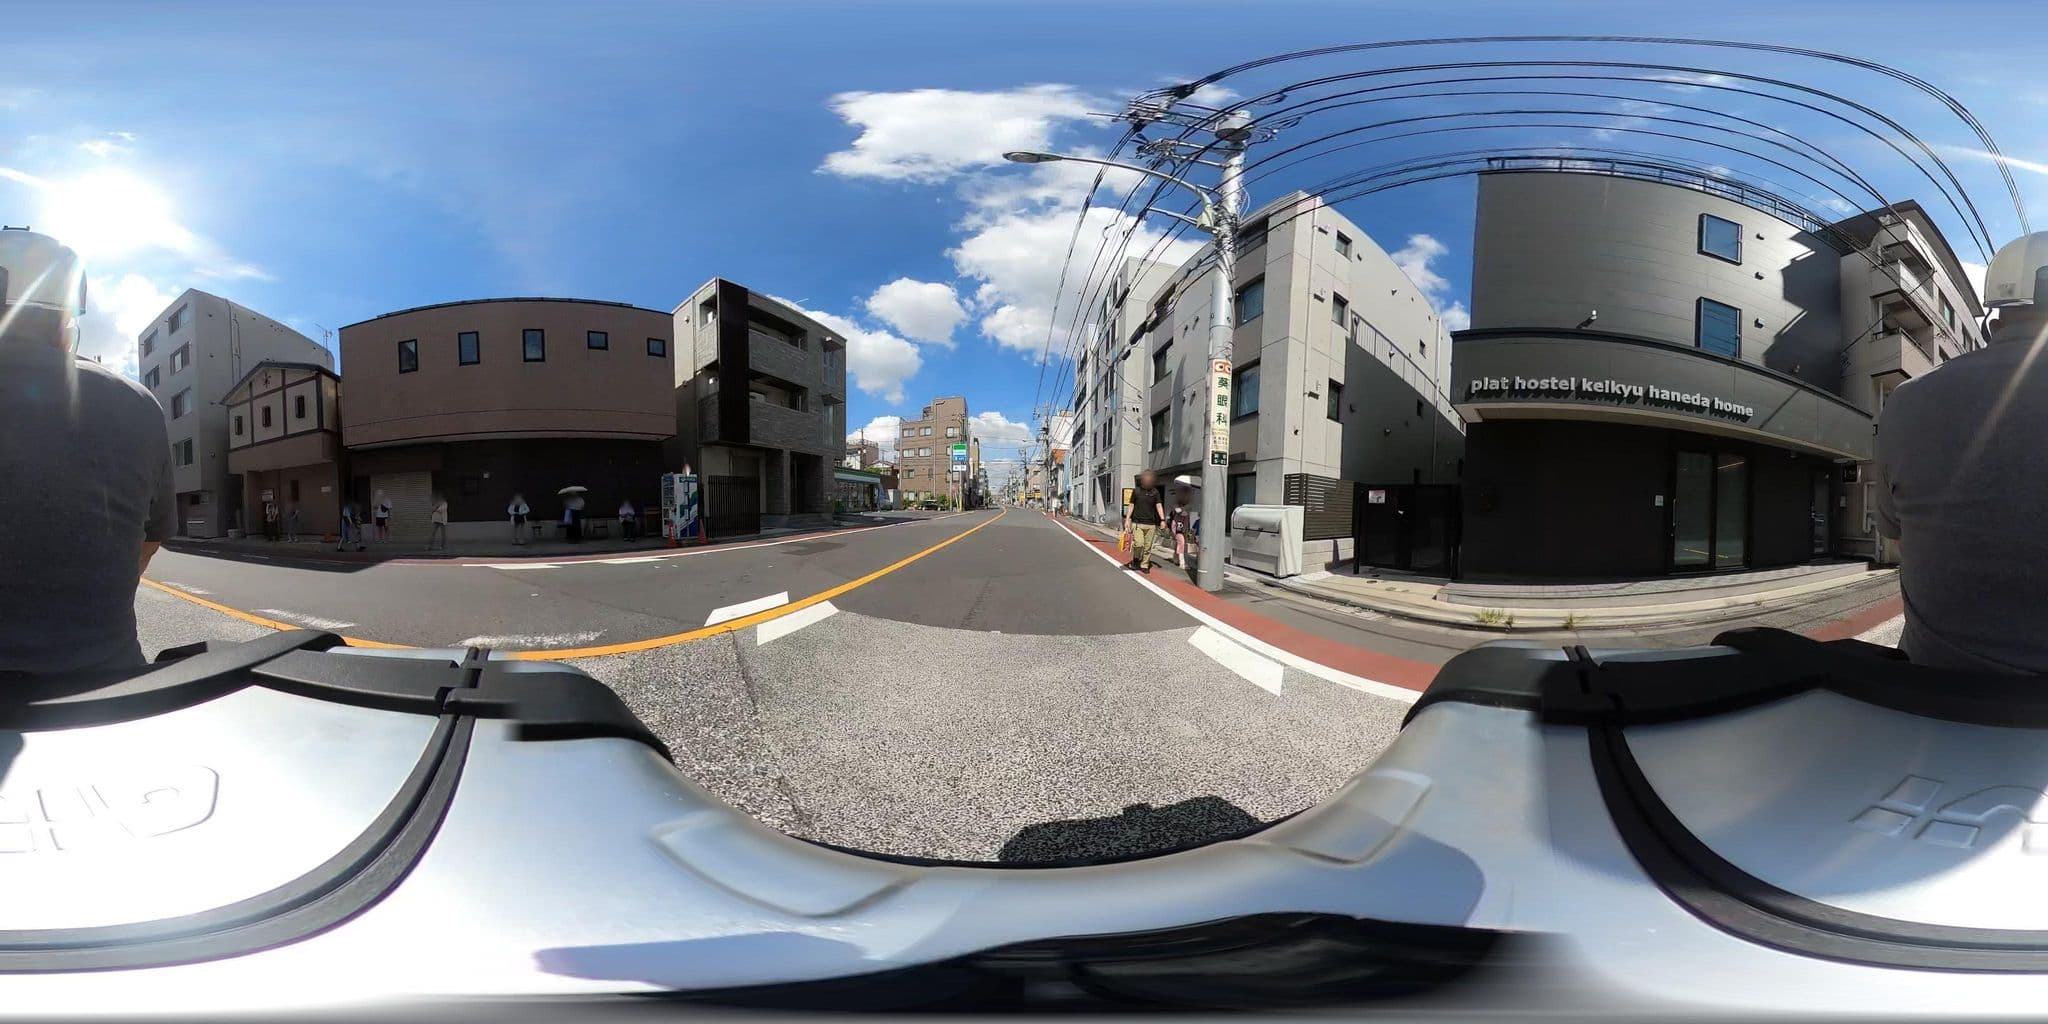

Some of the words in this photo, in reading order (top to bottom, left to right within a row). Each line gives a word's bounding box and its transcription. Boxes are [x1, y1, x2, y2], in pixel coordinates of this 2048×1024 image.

[1216, 376, 1229, 426] 葵眼科
[1471, 376, 1509, 394] plat
[1514, 375, 1576, 391] hostel
[1649, 385, 1711, 407] haneda
[1714, 397, 1754, 417] home
